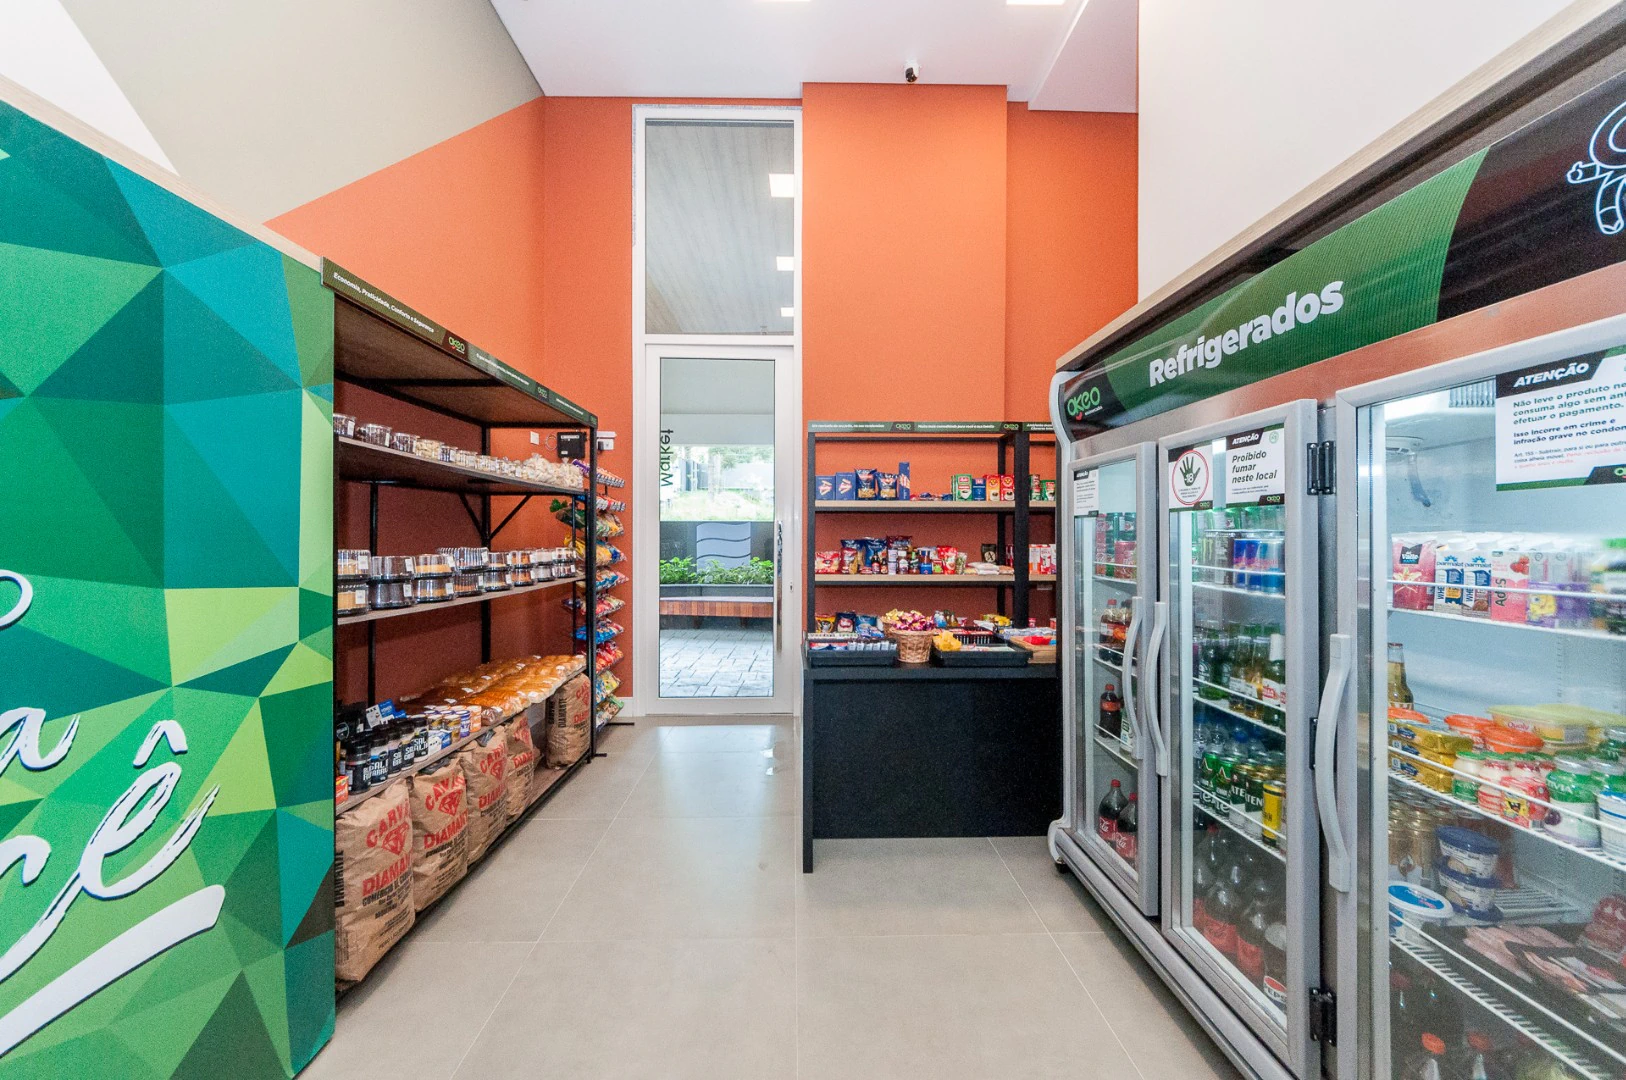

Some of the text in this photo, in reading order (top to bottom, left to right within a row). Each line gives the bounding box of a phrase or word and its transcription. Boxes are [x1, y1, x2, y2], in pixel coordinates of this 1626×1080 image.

[1150, 280, 1344, 388] Refrigerados
[1513, 362, 1590, 387] ATENÇÃO
[1513, 400, 1531, 408] Não
[1534, 395, 1554, 404] leve
[1566, 384, 1610, 400] produto
[1513, 405, 1555, 417] consuma
[1558, 399, 1581, 409] algo
[1583, 395, 1607, 404] sem
[1513, 415, 1547, 425] efetuar
[1559, 401, 1624, 419] pagamento.
[1232, 432, 1260, 445] ATENÇÃO
[1513, 430, 1529, 438] Isso
[1531, 426, 1561, 435] incorre
[1580, 419, 1607, 429] crime
[1513, 435, 1547, 445] infração
[1548, 433, 1573, 442] grave
[1231, 450, 1267, 463] Proibido
[1231, 464, 1257, 473] fumar
[1231, 469, 1278, 484] neste local
[1495, 578, 1507, 607] AdS
